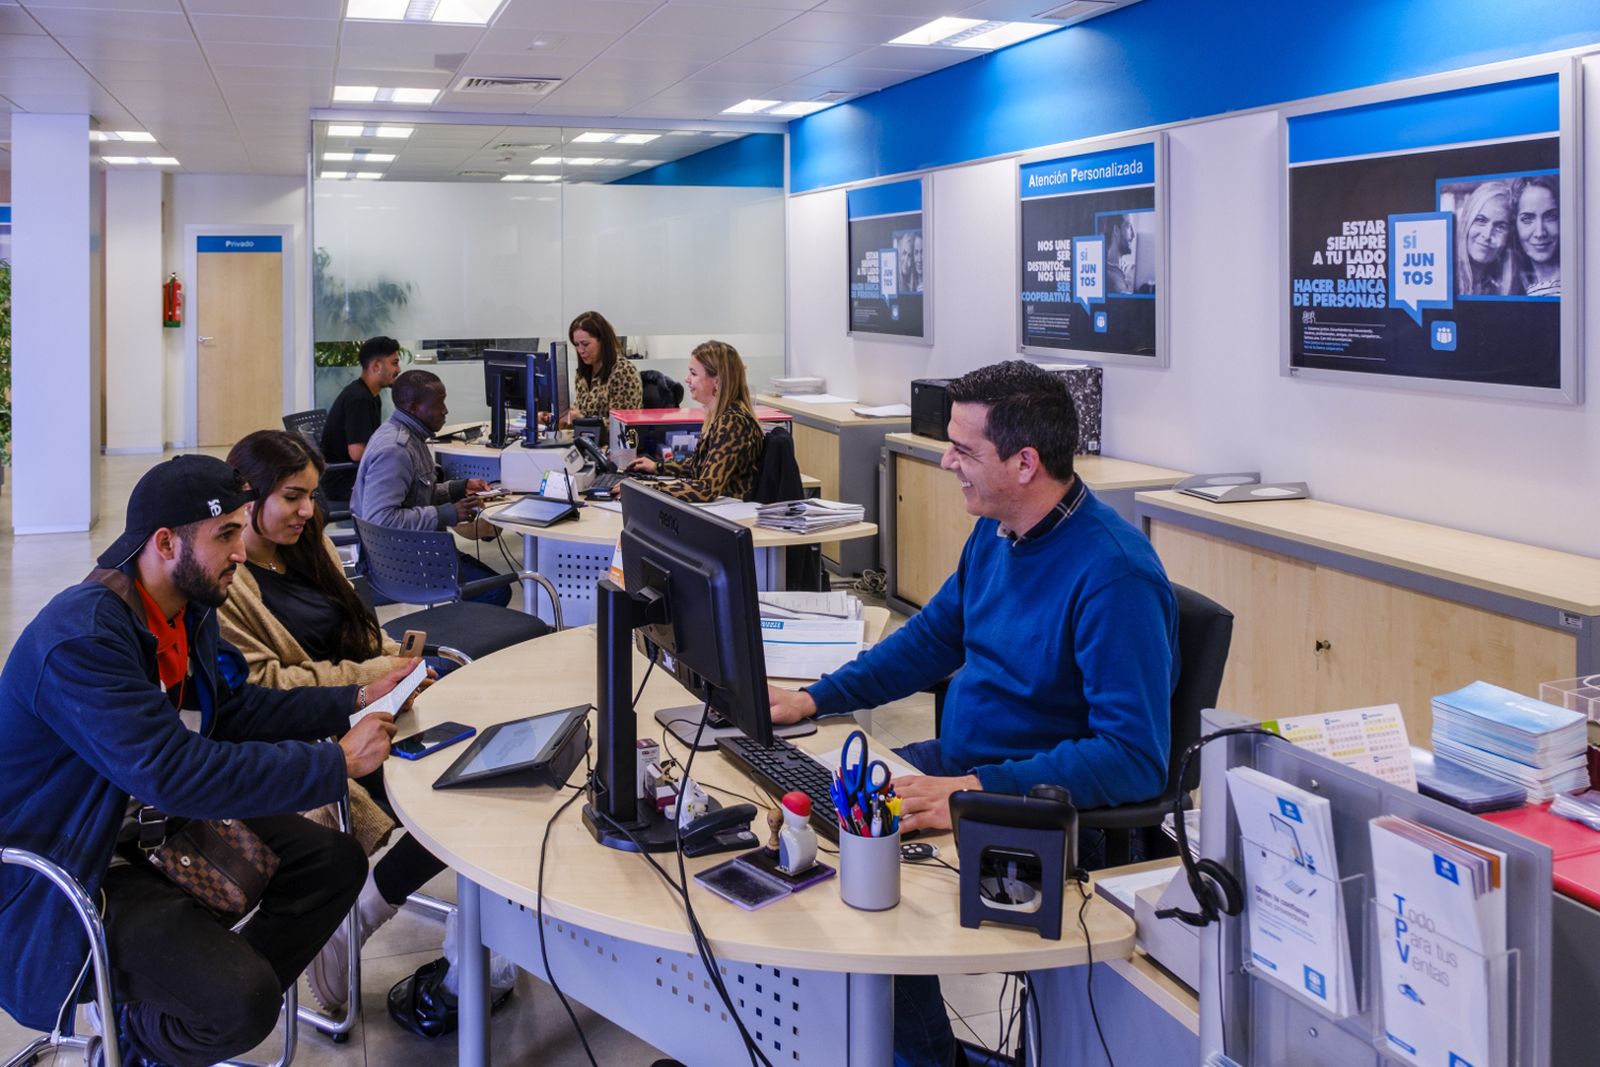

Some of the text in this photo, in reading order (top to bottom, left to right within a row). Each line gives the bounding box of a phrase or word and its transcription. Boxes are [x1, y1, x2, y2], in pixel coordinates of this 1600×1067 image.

[1028, 159, 1143, 188] Atención Personalizada
[1342, 220, 1386, 236] ESTAR
[225, 240, 255, 248] Privado
[1037, 240, 1071, 252] NOS UNE
[1326, 235, 1386, 251] SIEMPRE
[1056, 250, 1071, 261] SER
[1312, 249, 1386, 265] A TU LADO
[1403, 252, 1434, 267] JUN
[1080, 263, 1097, 274] JUN
[1346, 264, 1386, 279] PARA
[1037, 271, 1071, 282] NOS UNE
[1080, 277, 1096, 287] TOS
[1403, 271, 1433, 285] TOS
[1056, 282, 1071, 292] SER
[1294, 279, 1386, 294] HACER BANCA
[1021, 291, 1071, 303] COOPERATIVA
[1293, 293, 1386, 308] DE PERSONAS
[1435, 942, 1458, 969] tus
